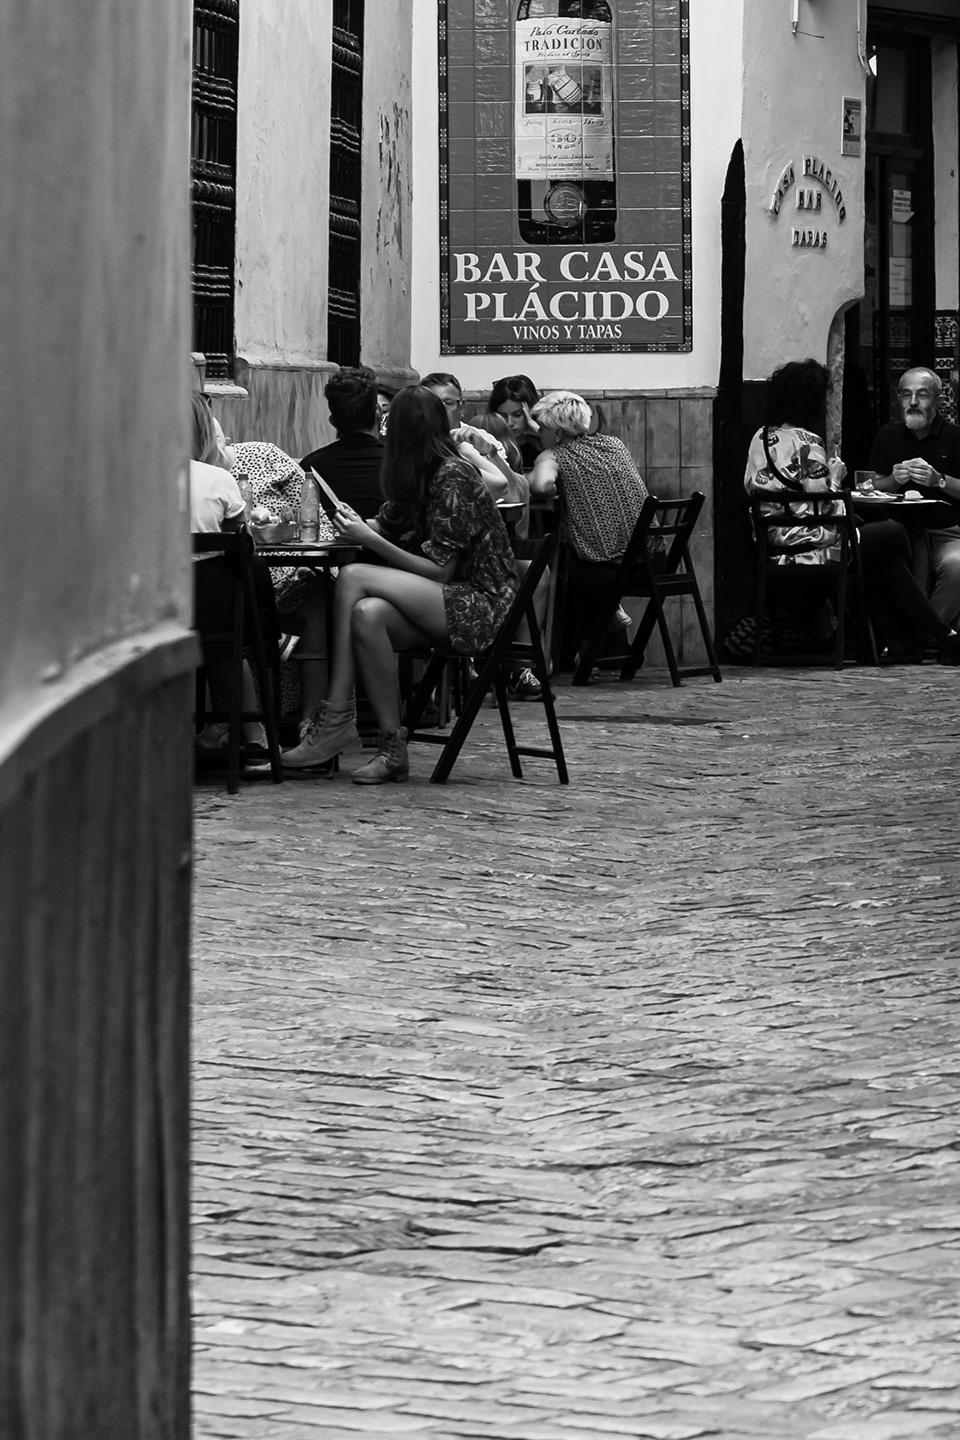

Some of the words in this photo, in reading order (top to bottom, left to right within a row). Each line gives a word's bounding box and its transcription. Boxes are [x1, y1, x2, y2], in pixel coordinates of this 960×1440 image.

[771, 164, 796, 215] CASA
[797, 189, 822, 210] BAR
[453, 251, 547, 283] BAR
[559, 250, 680, 282] CASA
[463, 282, 670, 323] PLÁCIDO
[512, 325, 560, 340] VINOS
[563, 325, 573, 339] Y
[576, 324, 623, 340] TAPAS
